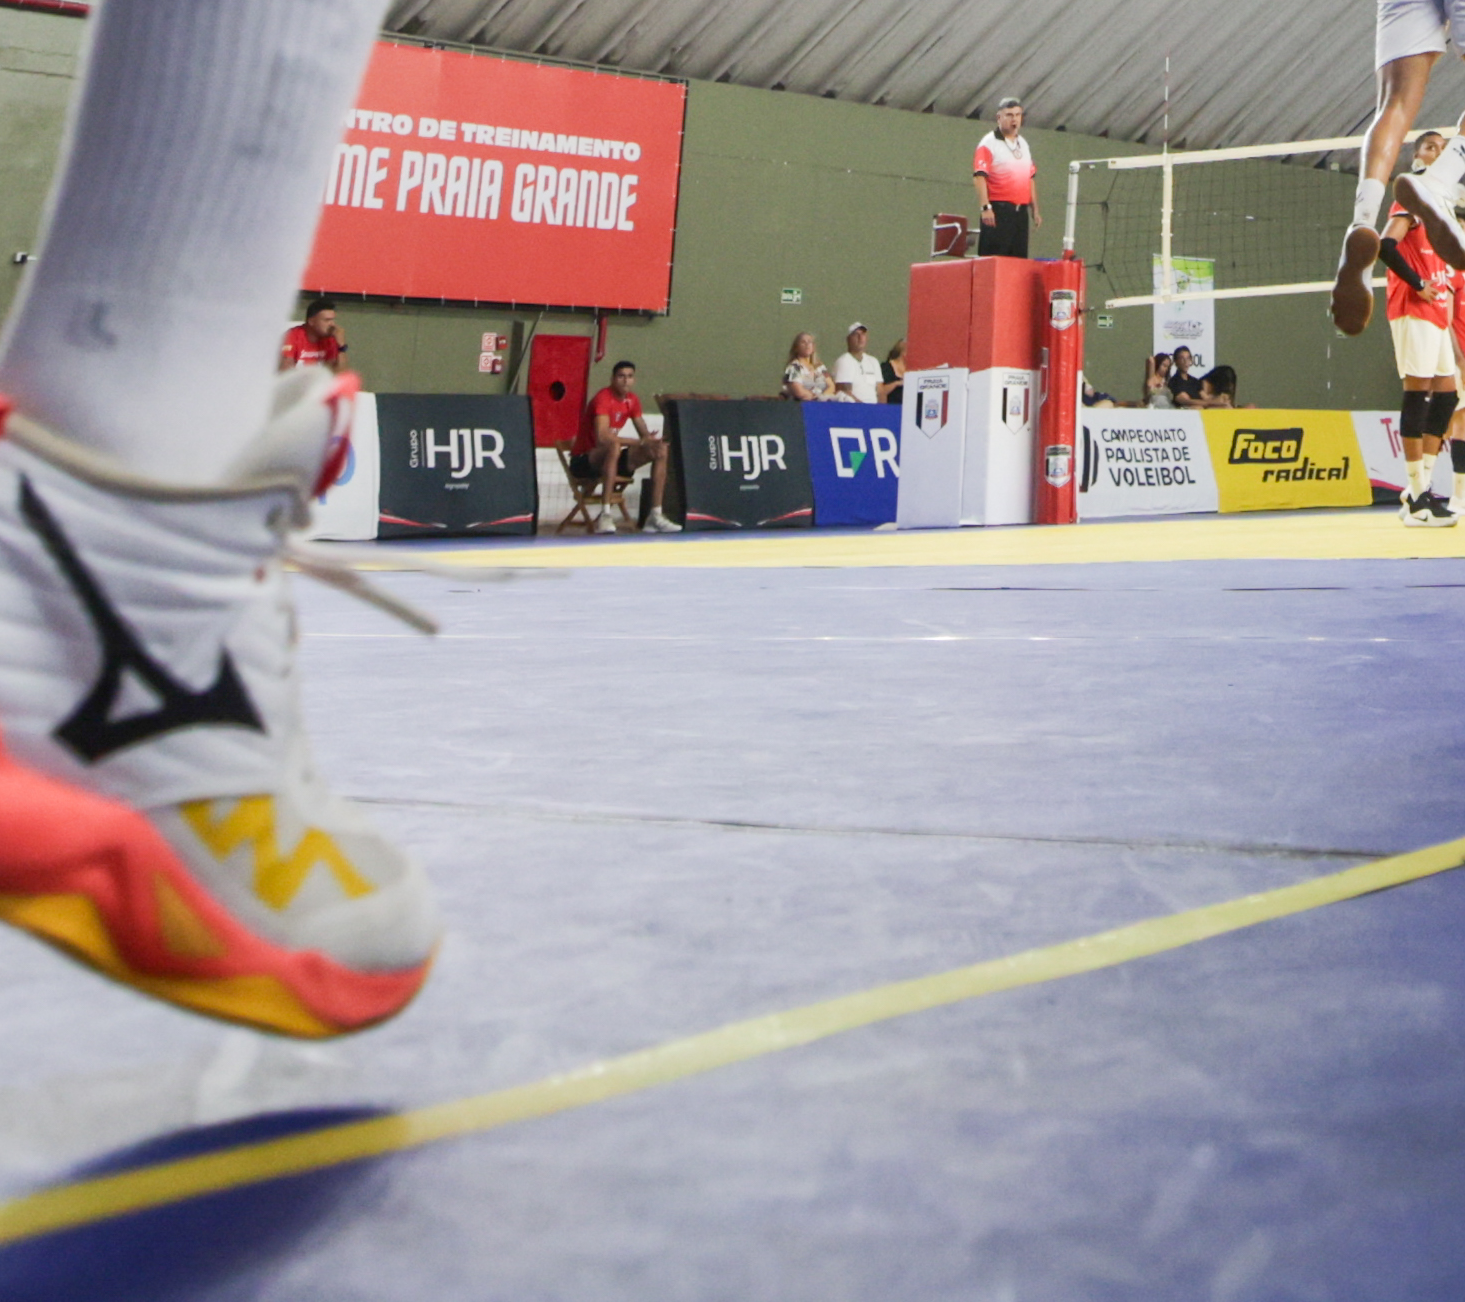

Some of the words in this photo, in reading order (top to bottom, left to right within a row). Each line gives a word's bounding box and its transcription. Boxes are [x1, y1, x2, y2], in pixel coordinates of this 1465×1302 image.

[418, 116, 458, 141] DE
[461, 121, 642, 162] TREINAMENTO
[395, 149, 505, 220] PRAIA
[510, 162, 640, 232] GRANDE
[1101, 427, 1187, 443] CAMPEONATO
[1233, 432, 1300, 460] Foco
[426, 427, 507, 479] HJR
[720, 434, 788, 481] HJR
[1105, 447, 1170, 463] PAULISTA
[1174, 446, 1192, 463] DE
[1108, 466, 1197, 487] VOLEIBOL
[1262, 456, 1351, 483] radical
